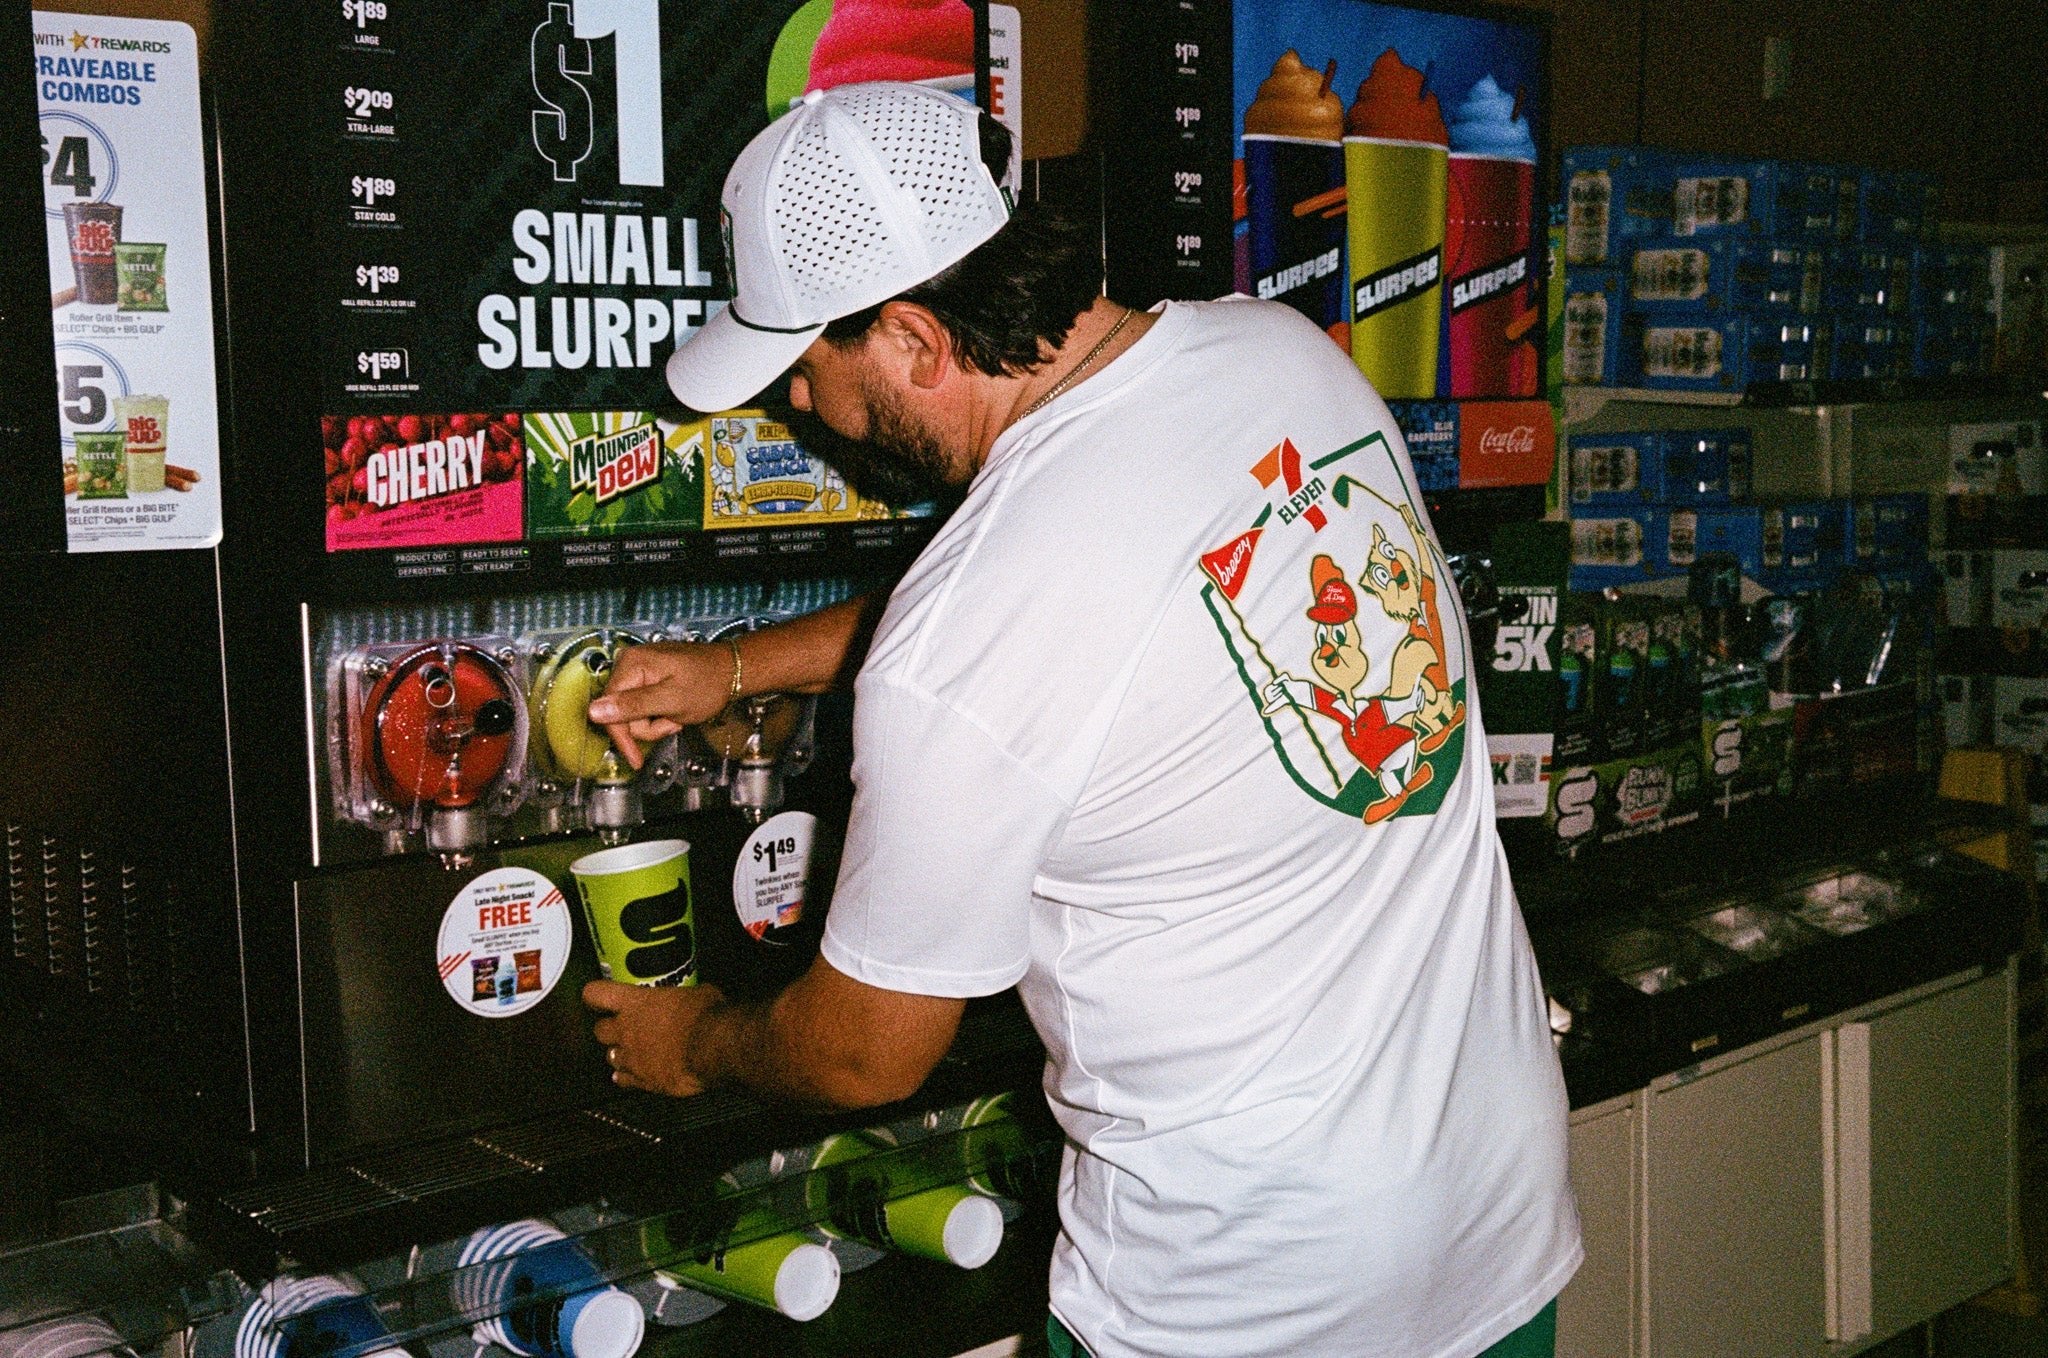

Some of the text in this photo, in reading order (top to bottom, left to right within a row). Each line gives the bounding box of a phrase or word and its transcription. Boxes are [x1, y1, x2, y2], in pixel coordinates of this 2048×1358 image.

[342, 0, 387, 28] $189
[354, 35, 380, 45] LARGE
[42, 80, 141, 105] COMBOS
[344, 86, 393, 118] $209
[347, 122, 395, 135] XTRA-LARGE
[351, 175, 396, 205] $189
[354, 211, 374, 221] STAY
[512, 209, 712, 287] SMALL
[356, 264, 400, 293] $139
[1257, 248, 1339, 299] SLURPEE
[1356, 255, 1439, 314] SLURPEE
[1453, 257, 1526, 308] SLURPEE
[477, 293, 736, 371] SLURPE
[358, 352, 400, 379] $159
[58, 365, 107, 425] 5
[128, 416, 157, 430] BIG
[1480, 426, 1534, 453] Coca-Cola
[367, 430, 485, 507] CHERRY
[101, 504, 124, 513] Items
[1277, 476, 1326, 525] ELEVEN
[68, 516, 98, 525] SELECT
[105, 515, 127, 525] Chips
[136, 515, 150, 523] BIG
[396, 552, 447, 563] PRODUCT OUT
[463, 548, 523, 559] READY TO SERVE
[563, 543, 612, 552] PRODUCT OUT
[625, 541, 647, 550] READY
[659, 539, 680, 548] SERVE
[634, 553, 647, 561] NOT
[398, 566, 447, 576] DEFROSTING
[473, 562, 514, 571] NOT READY
[1213, 536, 1252, 586] breezy
[1492, 625, 1556, 672] 5K
[753, 837, 796, 873] $149
[480, 902, 531, 930] FREE
